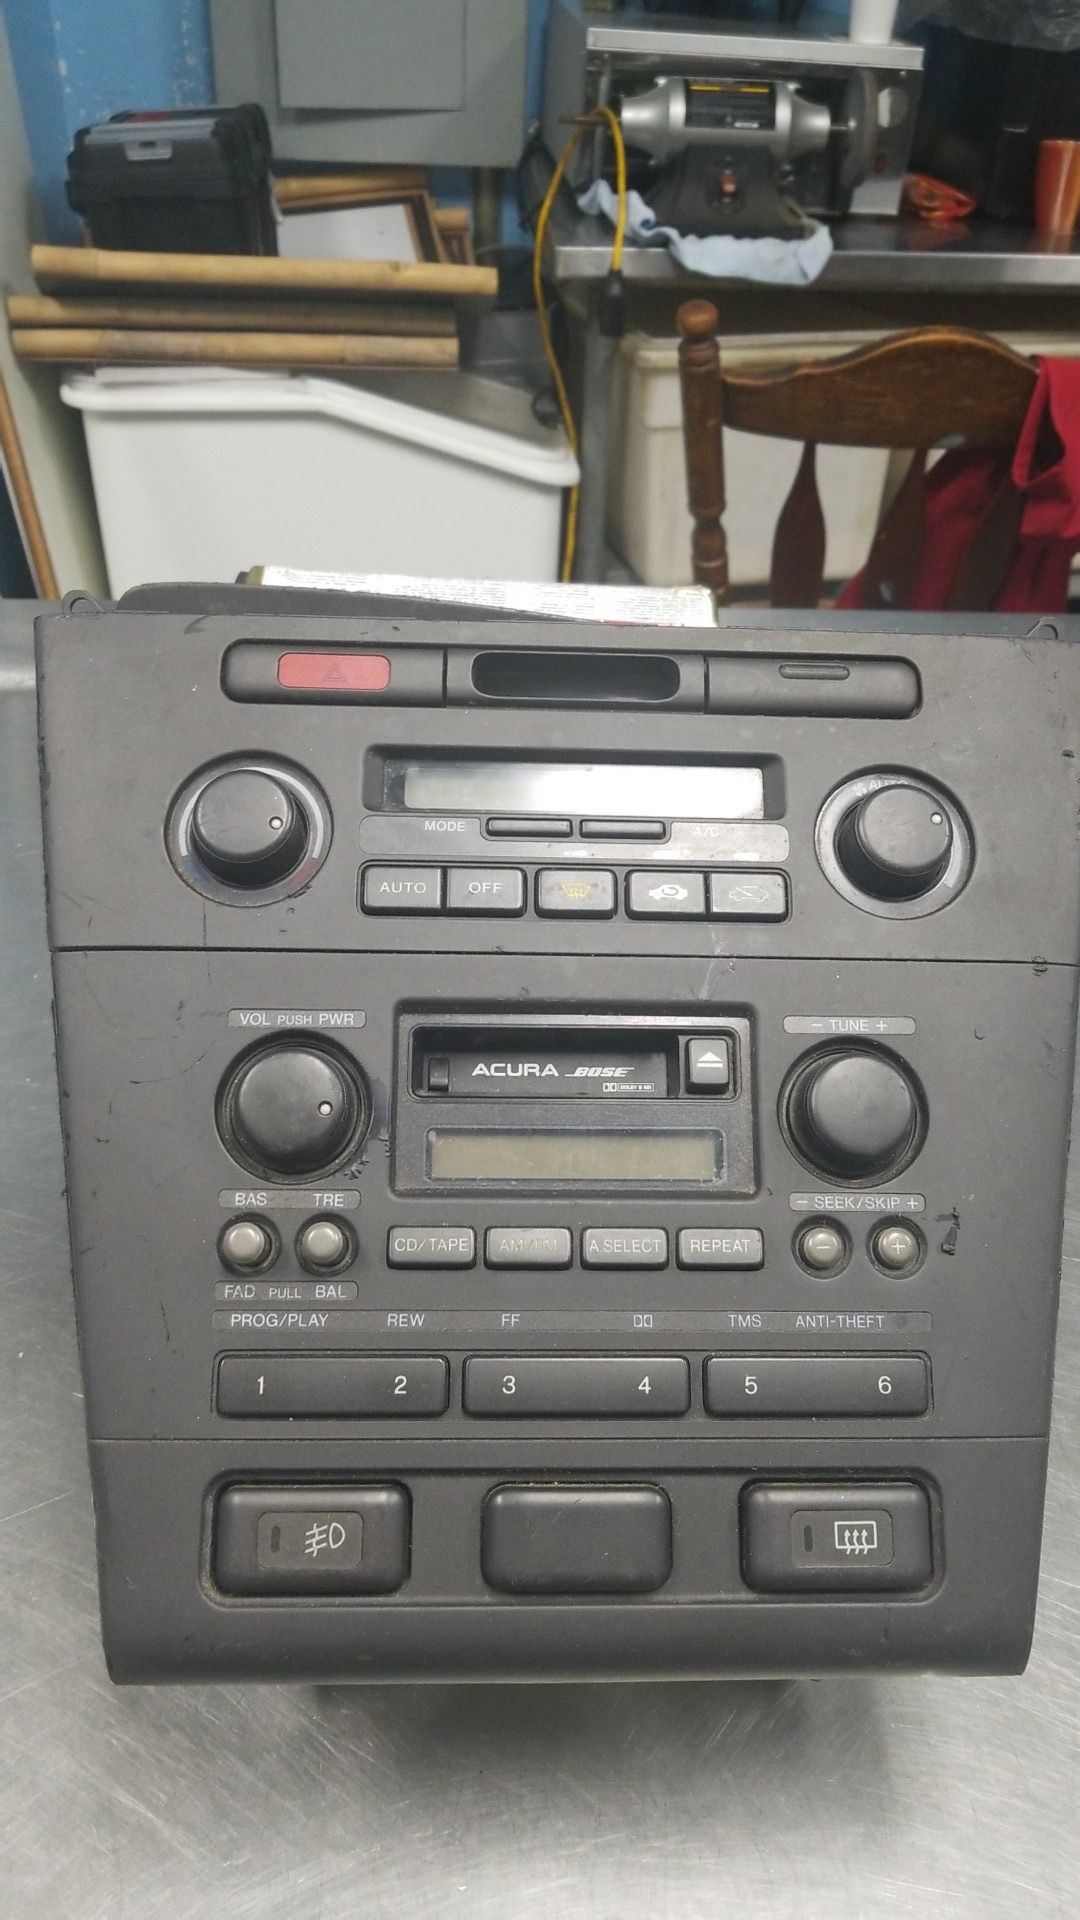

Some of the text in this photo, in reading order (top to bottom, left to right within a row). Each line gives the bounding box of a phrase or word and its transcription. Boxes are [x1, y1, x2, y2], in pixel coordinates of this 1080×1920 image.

[424, 820, 465, 832] MODE
[693, 825, 720, 838] A/C
[379, 881, 427, 894] AUTO
[469, 881, 502, 894] OFF
[240, 1013, 354, 1026] VOL PUSH PWR
[829, 1019, 869, 1032] TUNE
[471, 1063, 635, 1078] ACURA BOSE
[234, 1193, 345, 1207] BAS TRE
[814, 1195, 901, 1209] SEEK/SKIP
[394, 1238, 469, 1252] CD/TAPE
[589, 1239, 661, 1253] A.SELECT
[690, 1239, 750, 1253] REPEAT
[224, 1285, 347, 1299] FAD PULL BAL
[230, 1314, 885, 1329] PROG/PLAY REW FF TMS ANTI-THEFT
[256, 1375, 408, 1395] 1 2
[502, 1375, 652, 1395] 3 4
[744, 1376, 892, 1395] 5 6
